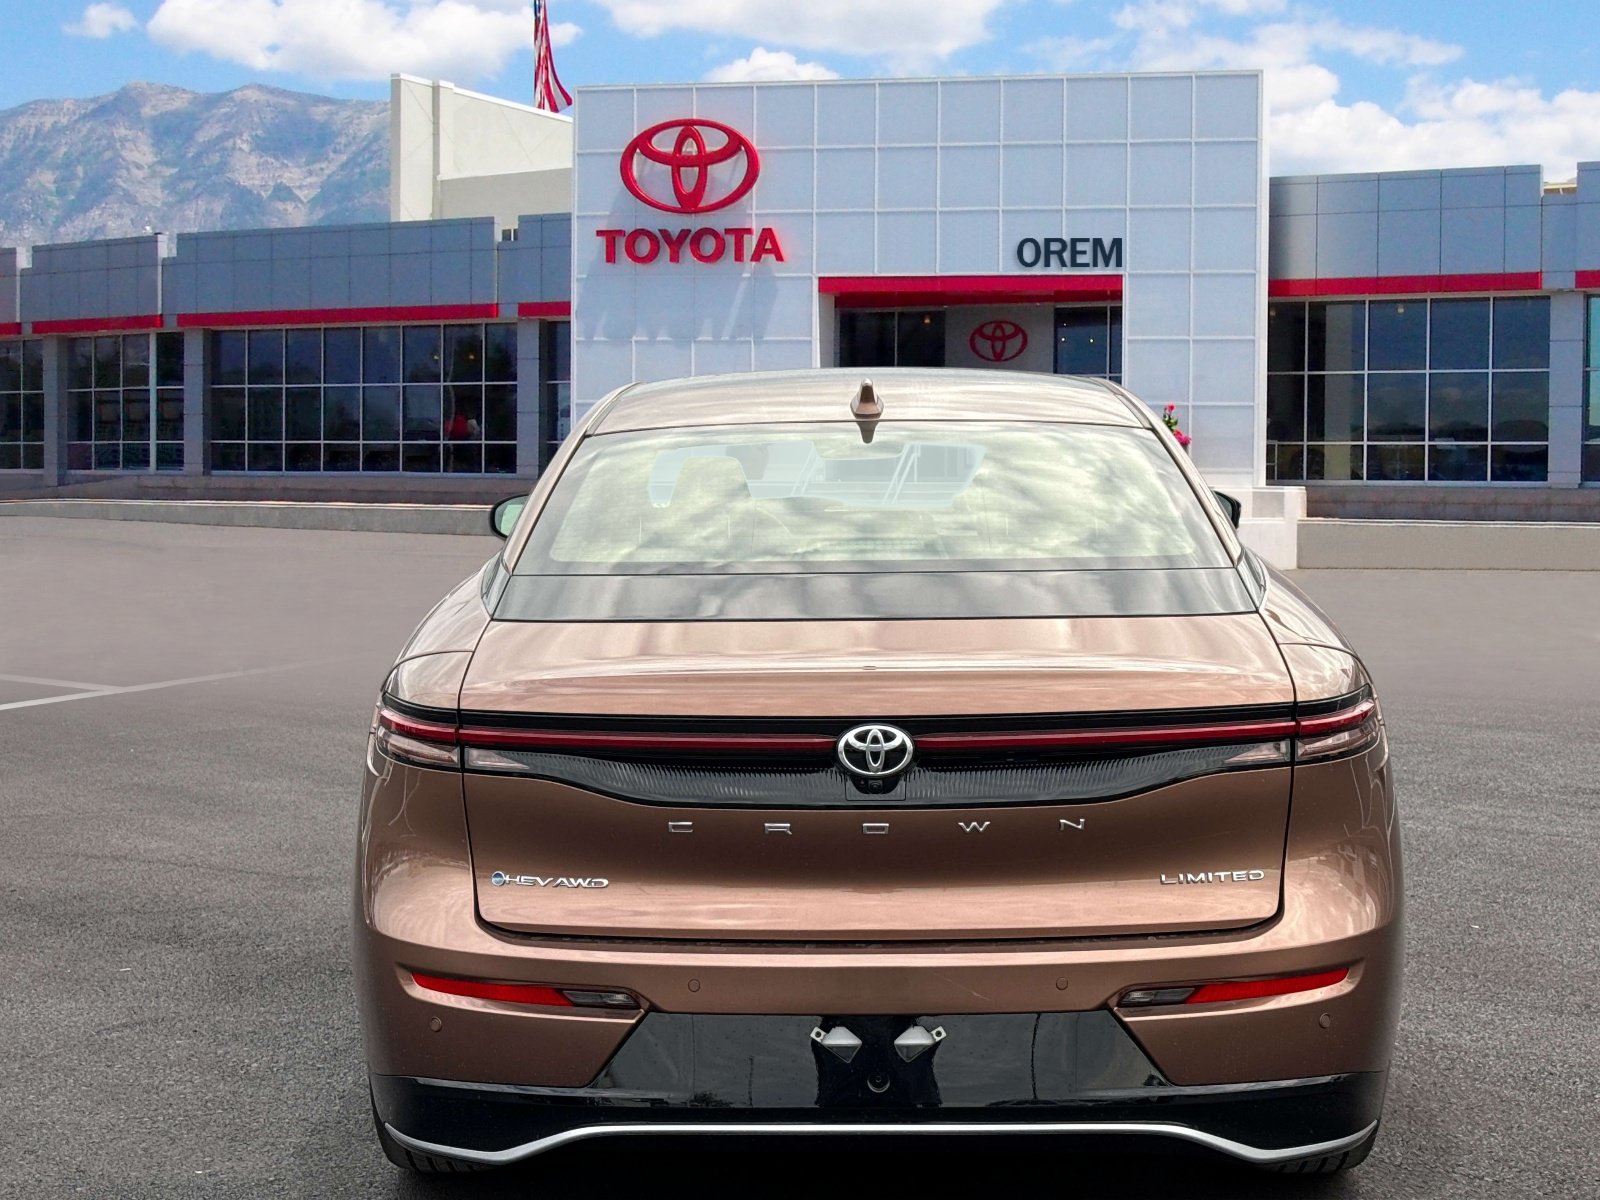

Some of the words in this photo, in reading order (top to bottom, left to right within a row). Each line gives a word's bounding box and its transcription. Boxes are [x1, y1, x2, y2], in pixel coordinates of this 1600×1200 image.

[596, 227, 784, 264] TOYOTA
[1017, 237, 1122, 268] OREM
[668, 818, 1086, 835] CROWN
[1160, 869, 1265, 885] LIMITED
